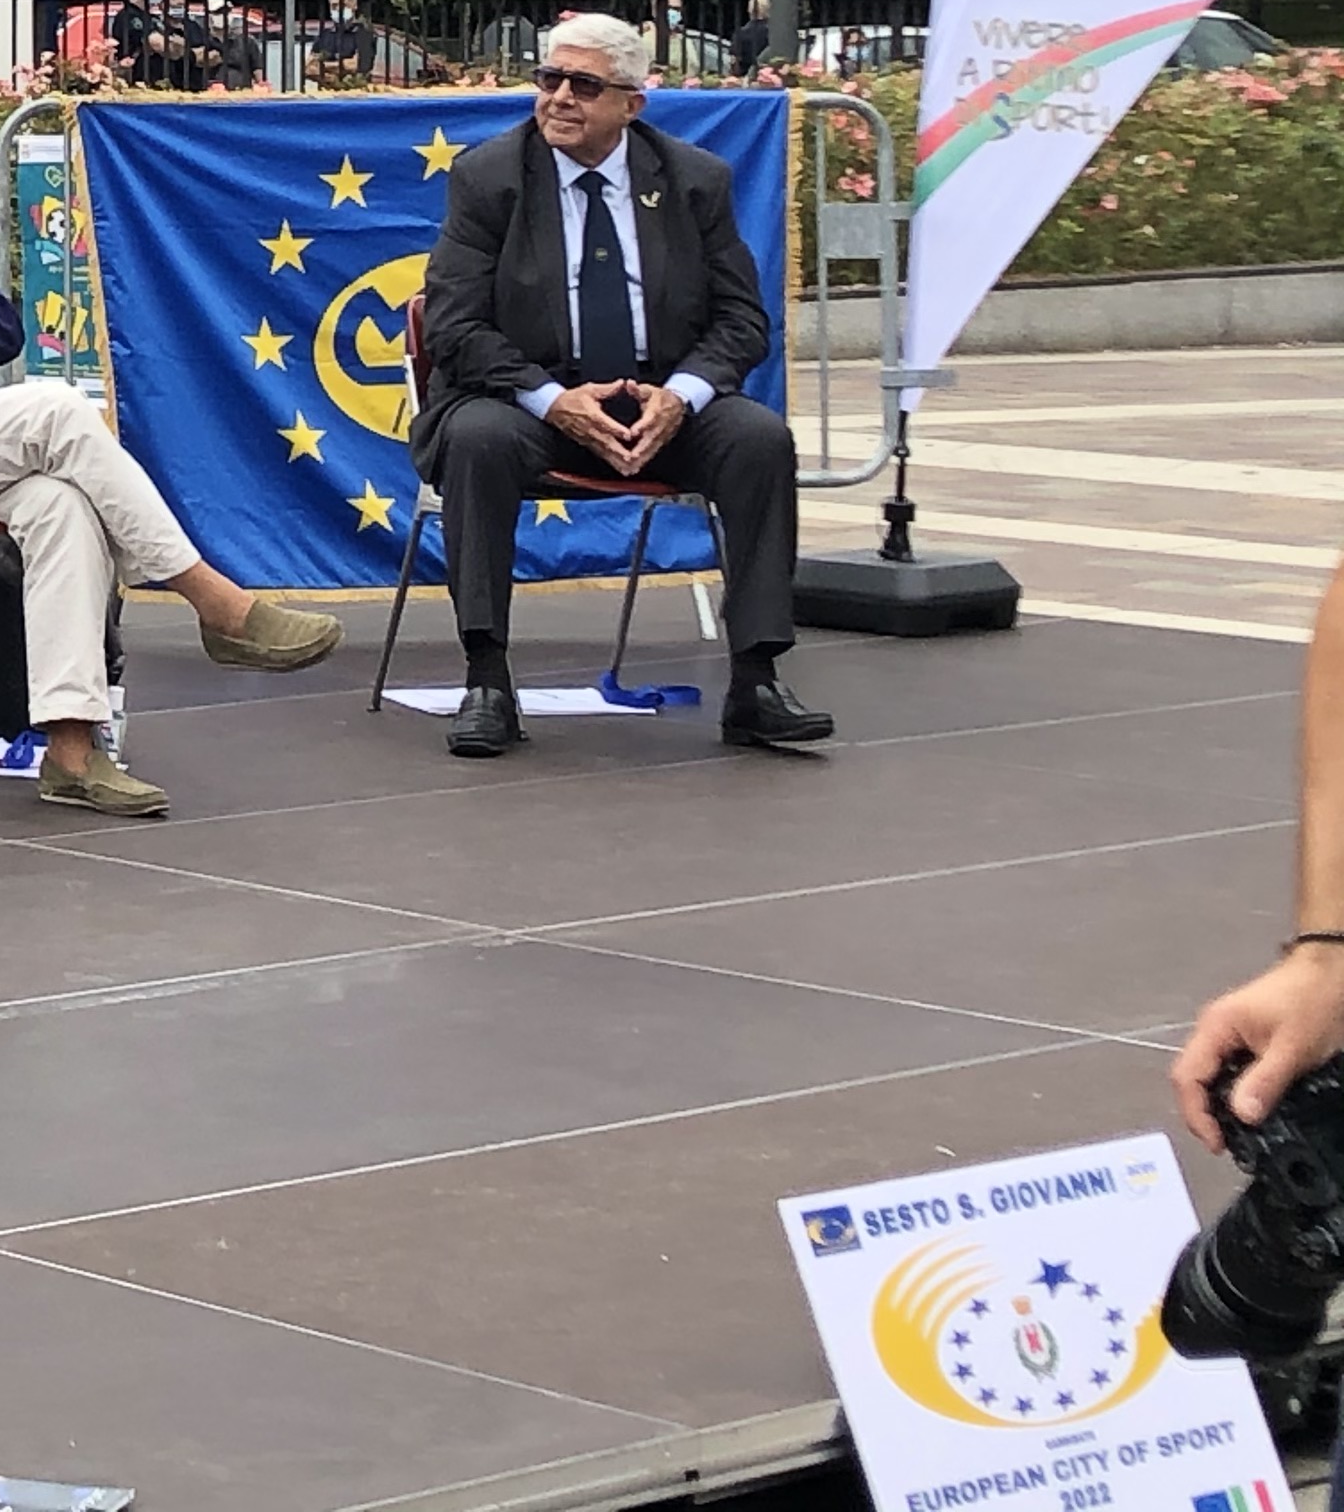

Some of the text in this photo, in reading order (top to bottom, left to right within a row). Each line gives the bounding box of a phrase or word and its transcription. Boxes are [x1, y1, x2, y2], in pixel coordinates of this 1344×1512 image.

[957, 57, 980, 86] A
[863, 1198, 950, 1237] SESTO
[957, 1192, 985, 1220] S.
[989, 1166, 1118, 1215] GIOVANNI
[905, 1420, 1236, 1512] EUROPEAN CITY OF SPORT
[1059, 1481, 1114, 1512] 2022
